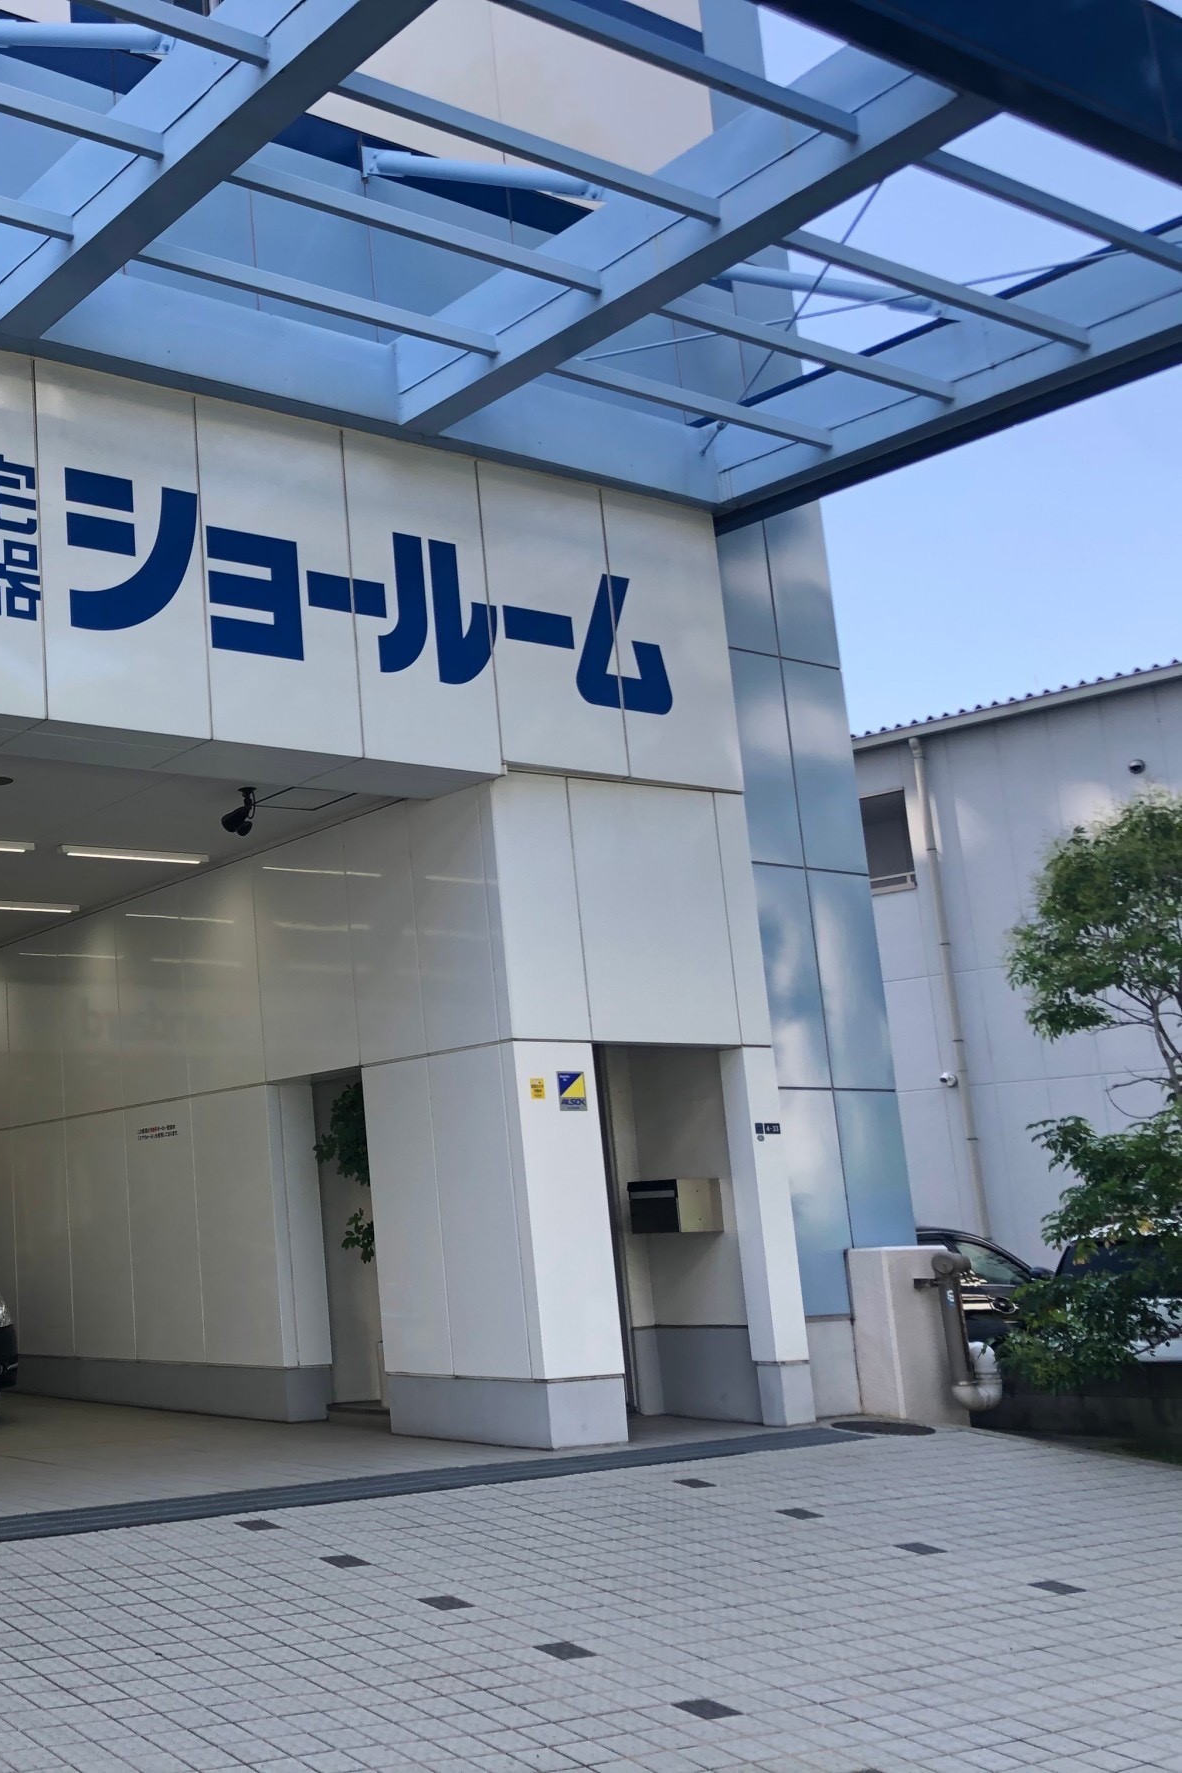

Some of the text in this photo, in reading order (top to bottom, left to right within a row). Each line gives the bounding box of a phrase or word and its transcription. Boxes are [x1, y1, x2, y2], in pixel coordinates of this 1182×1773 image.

[64, 466, 674, 716] ショールーム
